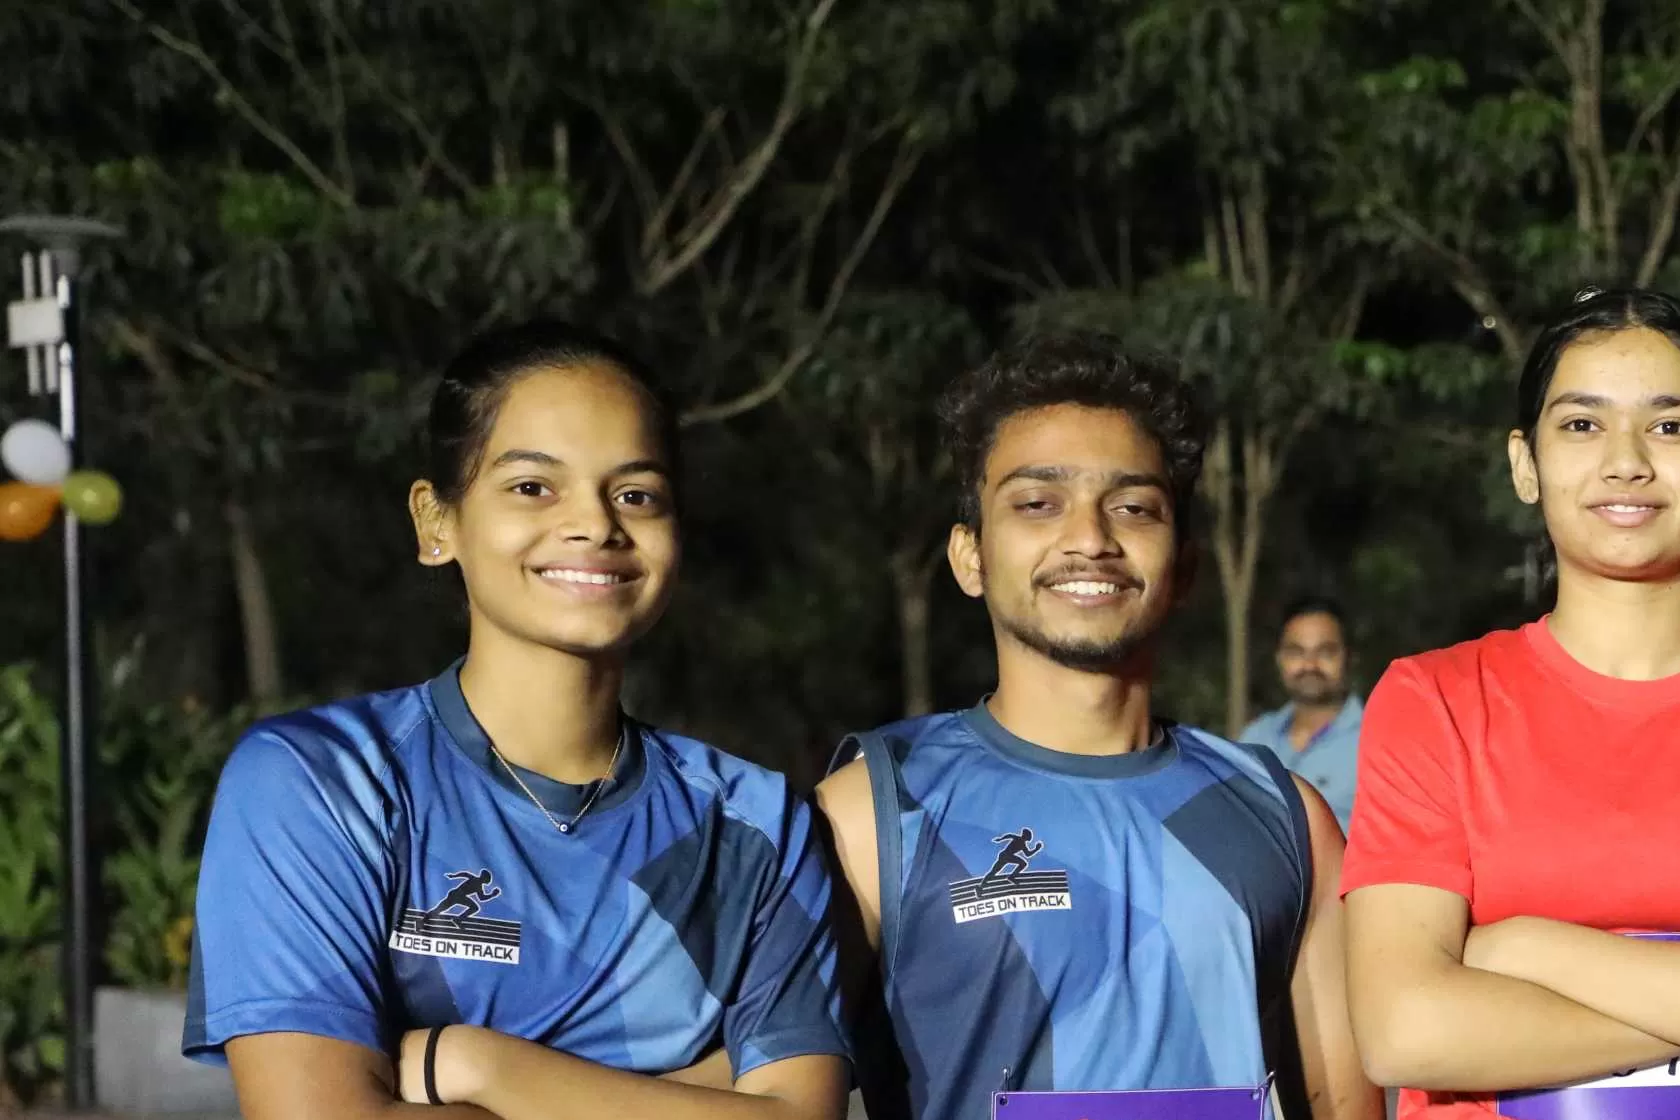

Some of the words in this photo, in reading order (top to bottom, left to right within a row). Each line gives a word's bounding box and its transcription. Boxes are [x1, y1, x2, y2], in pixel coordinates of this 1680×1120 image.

[958, 901, 995, 919] TOES
[998, 897, 1017, 911] ON
[1019, 895, 1066, 907] TRACK
[396, 933, 431, 952] TOES
[435, 940, 457, 954] ON
[462, 943, 513, 961] TRACK
